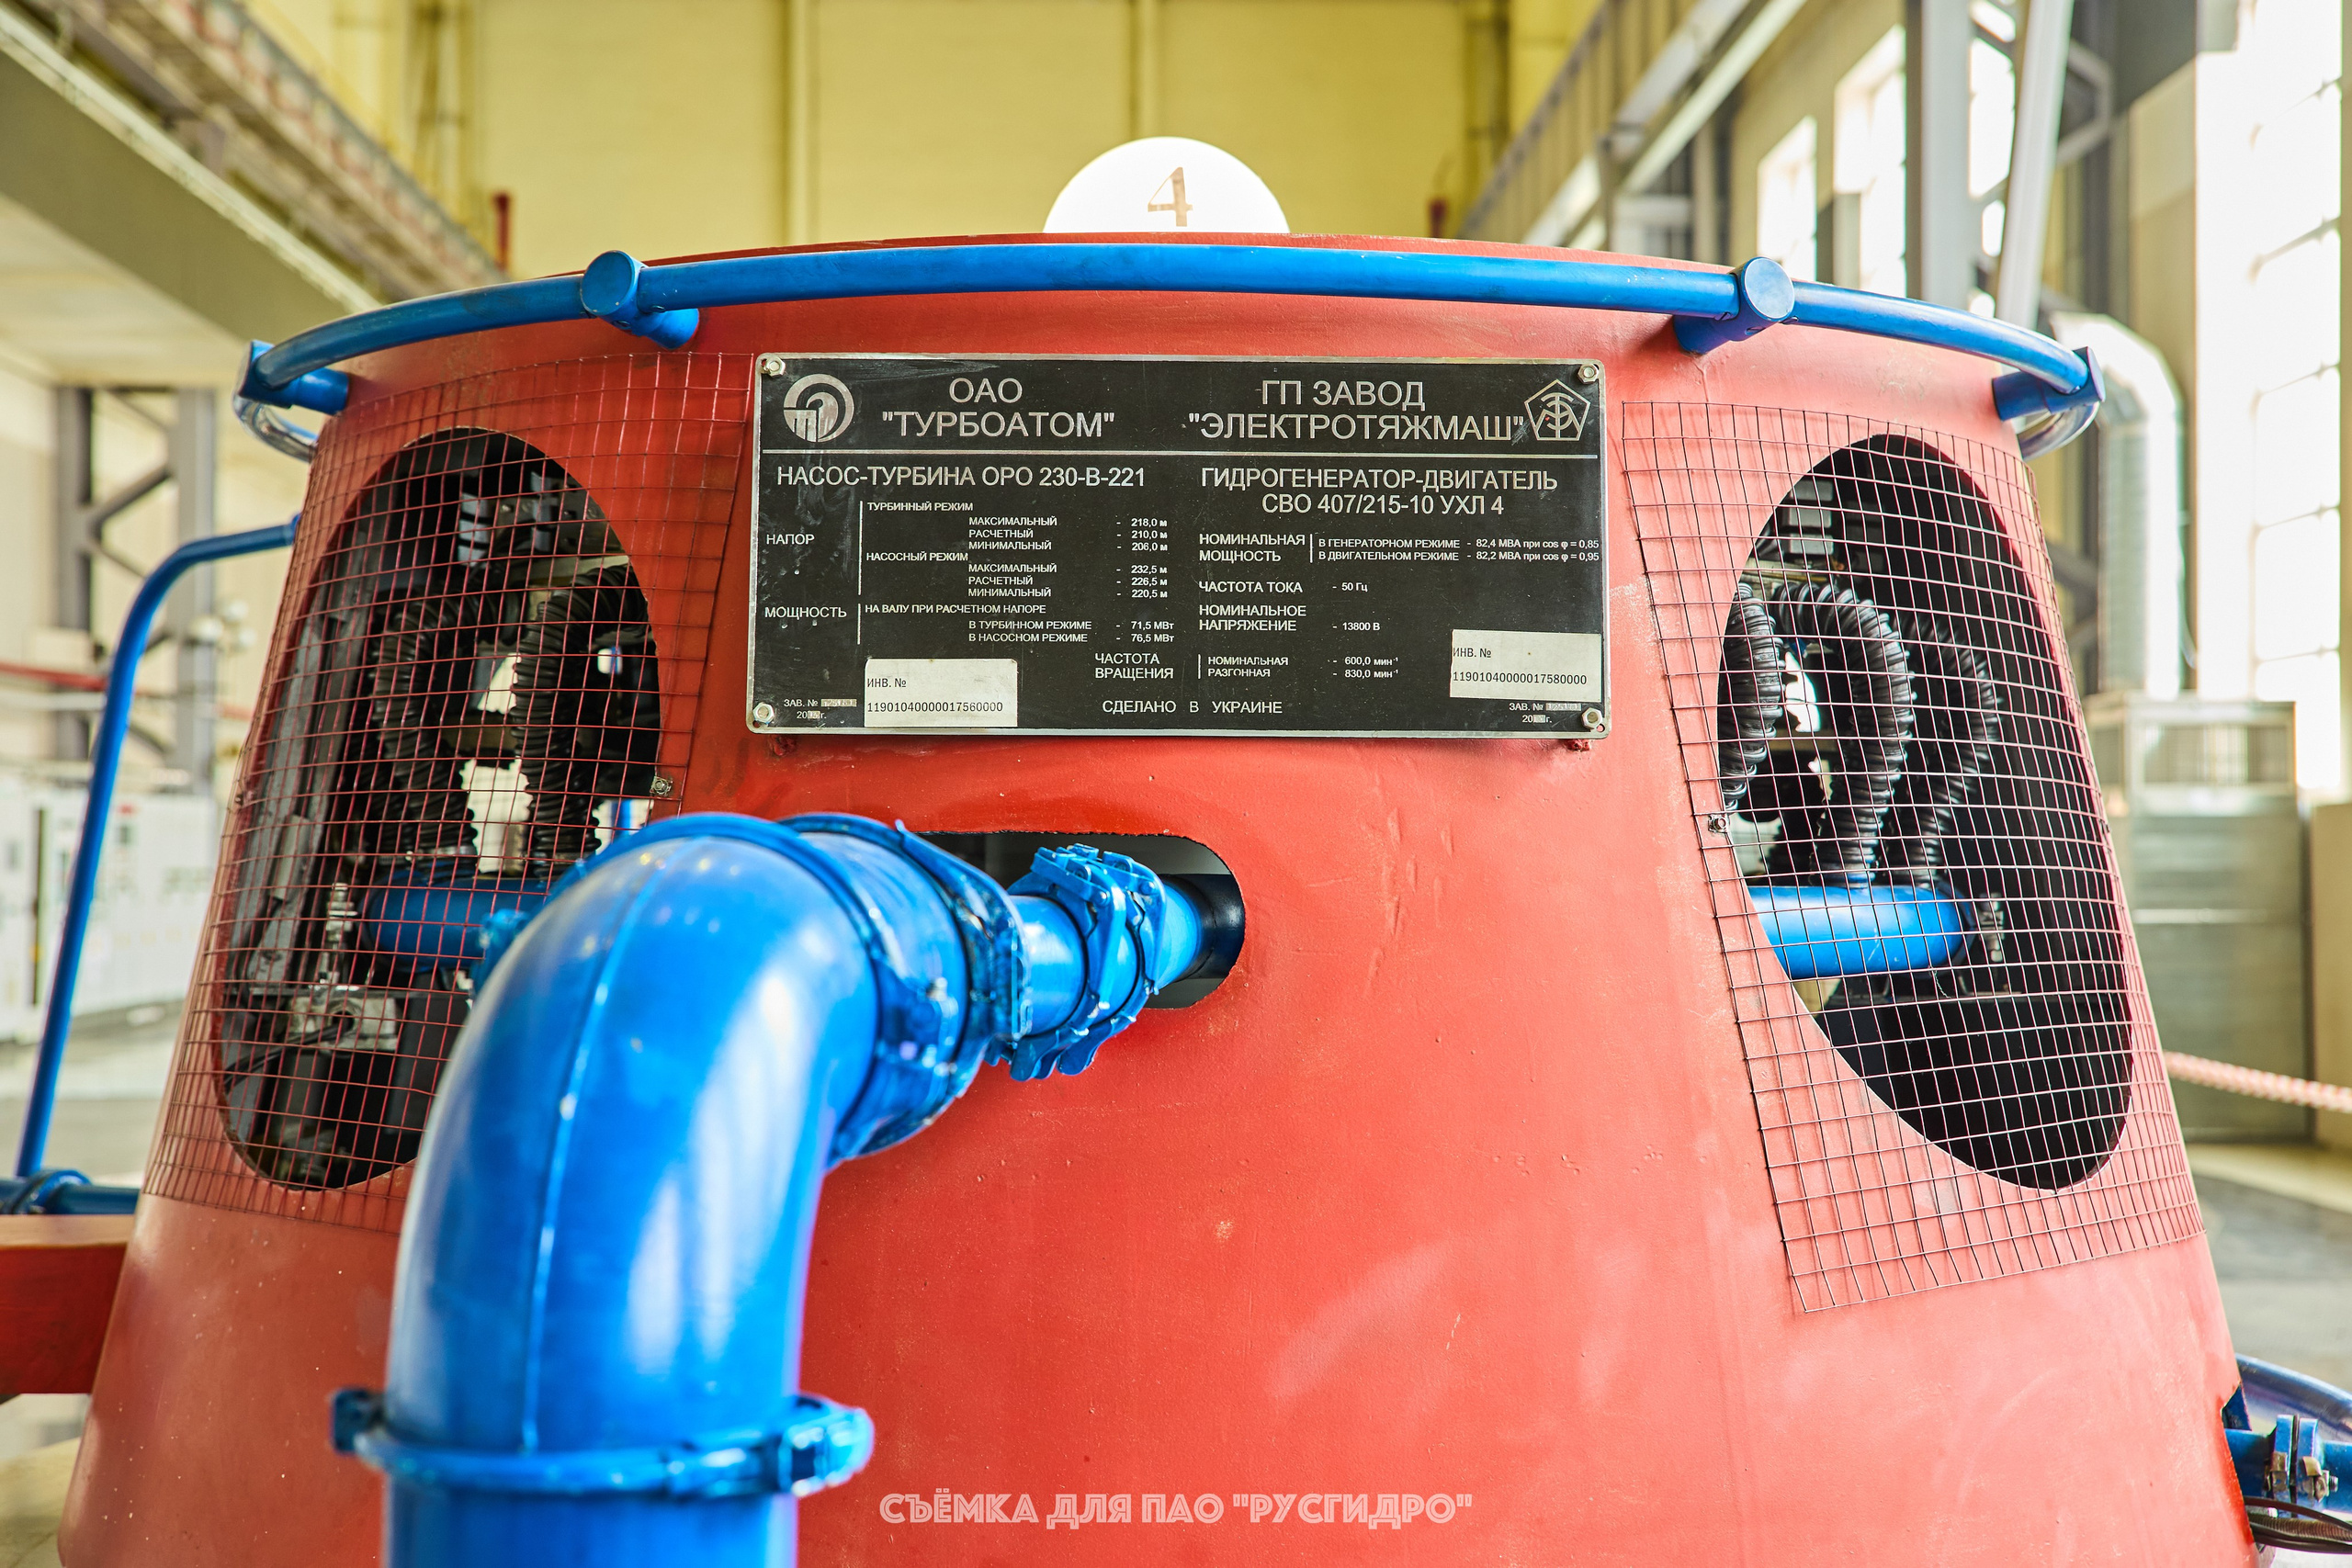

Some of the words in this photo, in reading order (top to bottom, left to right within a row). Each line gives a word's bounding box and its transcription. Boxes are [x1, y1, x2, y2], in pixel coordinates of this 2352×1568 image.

[1148, 166, 1193, 227] 4
[949, 378, 1022, 403] ОАО
[1262, 380, 1301, 404] ГП
[1313, 380, 1425, 411] ЗАВОД
[883, 412, 1114, 437] "ТУРБОАТОМ"
[1189, 413, 1525, 442] "ЭЛЕКТРОТЯЖМАШ"
[778, 465, 975, 485] НАСОС-ТУРБИНА
[982, 467, 1033, 485] ОРО
[1039, 468, 1143, 486] 230-В-221
[1203, 468, 1557, 492] ГИДРОГЕНЕРАТОР-ДВИГАТЕЛЬ
[867, 502, 932, 511] ТУРБИННЫЙ
[934, 502, 973, 511] РЕЖИМ
[1262, 493, 1311, 513] СВО
[1317, 494, 1433, 513] 407/215-10
[1440, 495, 1484, 514] УХЛ
[1491, 496, 1504, 514] 4
[969, 516, 1057, 525] МАКСИМАЛЬНЫЙ
[1132, 518, 1157, 527] 218,0
[969, 528, 1033, 537] РАСЧЕТНЫЙ
[1132, 530, 1158, 539] 210,0
[767, 534, 814, 545] НАПОР
[1200, 534, 1305, 545] НОМИНАЛЬНАЯ
[1329, 539, 1412, 547] ГЕНЕРАТОРНОМ
[1476, 539, 1496, 548] 82,4
[1498, 539, 1521, 547] МВА
[1523, 541, 1540, 549] при
[1579, 540, 1599, 549] 0,85
[969, 540, 1051, 549] МИНИМАЛЬНЫЙ
[1132, 543, 1158, 551] 206,0
[866, 551, 927, 560] НАСОСНЫЙ
[1200, 550, 1281, 563] МОЩНОСТЬ
[1319, 551, 1326, 559] В
[1328, 551, 1411, 561] ДВИГАТЕЛЬНОМ
[1414, 552, 1459, 560] РЕЖИМЕ
[1476, 551, 1496, 560] 82,2
[1523, 554, 1540, 562] при
[1579, 552, 1599, 561] 0,95
[969, 563, 1057, 572] МАКСИМАЛЬНЫЙ
[1131, 565, 1157, 574] 232,5
[968, 575, 1033, 584] РАСЧЕТНЫЙ
[1132, 577, 1158, 586] 226,5
[1199, 581, 1263, 592] ЧАСТОТА
[1267, 582, 1303, 592] ТОКА
[1342, 582, 1353, 591] 50
[1356, 582, 1367, 592] Гц
[968, 587, 1051, 596] МИНИМАЛЬНЫЙ
[1132, 590, 1158, 599] 220,5
[765, 606, 846, 620] МОЩНОСТЬ
[865, 604, 879, 613] НА
[882, 604, 909, 613] ВАЛУ
[912, 604, 933, 613] ПРИ
[936, 604, 1001, 613] РАСЧЕТНОМ
[1200, 604, 1306, 616] НОМИНАЛЬНОЕ
[978, 621, 1043, 629] ТУРБИННОМ
[1046, 621, 1091, 629] РЕЖИМЕ
[1131, 621, 1151, 630] 71,5
[1200, 620, 1296, 630] НАПРЯЖЕНИЕ
[1343, 622, 1371, 630] 13800
[1042, 634, 1087, 642] РЕЖИМЕ
[1131, 634, 1151, 643] 76,5
[1154, 634, 1174, 642] МВт
[1095, 653, 1159, 664] ЧАСТОТА
[1453, 648, 1476, 657] ИНВ.
[1480, 649, 1491, 658] №
[1208, 657, 1288, 665] НОМИНАЛЬНАЯ
[1345, 657, 1371, 666] 600,0
[1095, 667, 1173, 681] ВРАЩЕНИЯ
[1208, 669, 1270, 677] РАЗГОННАЯ
[1345, 670, 1371, 679] 830,0
[1453, 671, 1587, 684] 11901040000017580000
[867, 678, 891, 687] ИНВ.
[895, 678, 906, 687] №
[868, 702, 1002, 712] 11901040000017560000
[1102, 701, 1176, 715] СДЕЛАНО
[1190, 701, 1199, 712] В
[1212, 701, 1283, 713] УКРАИНЕ
